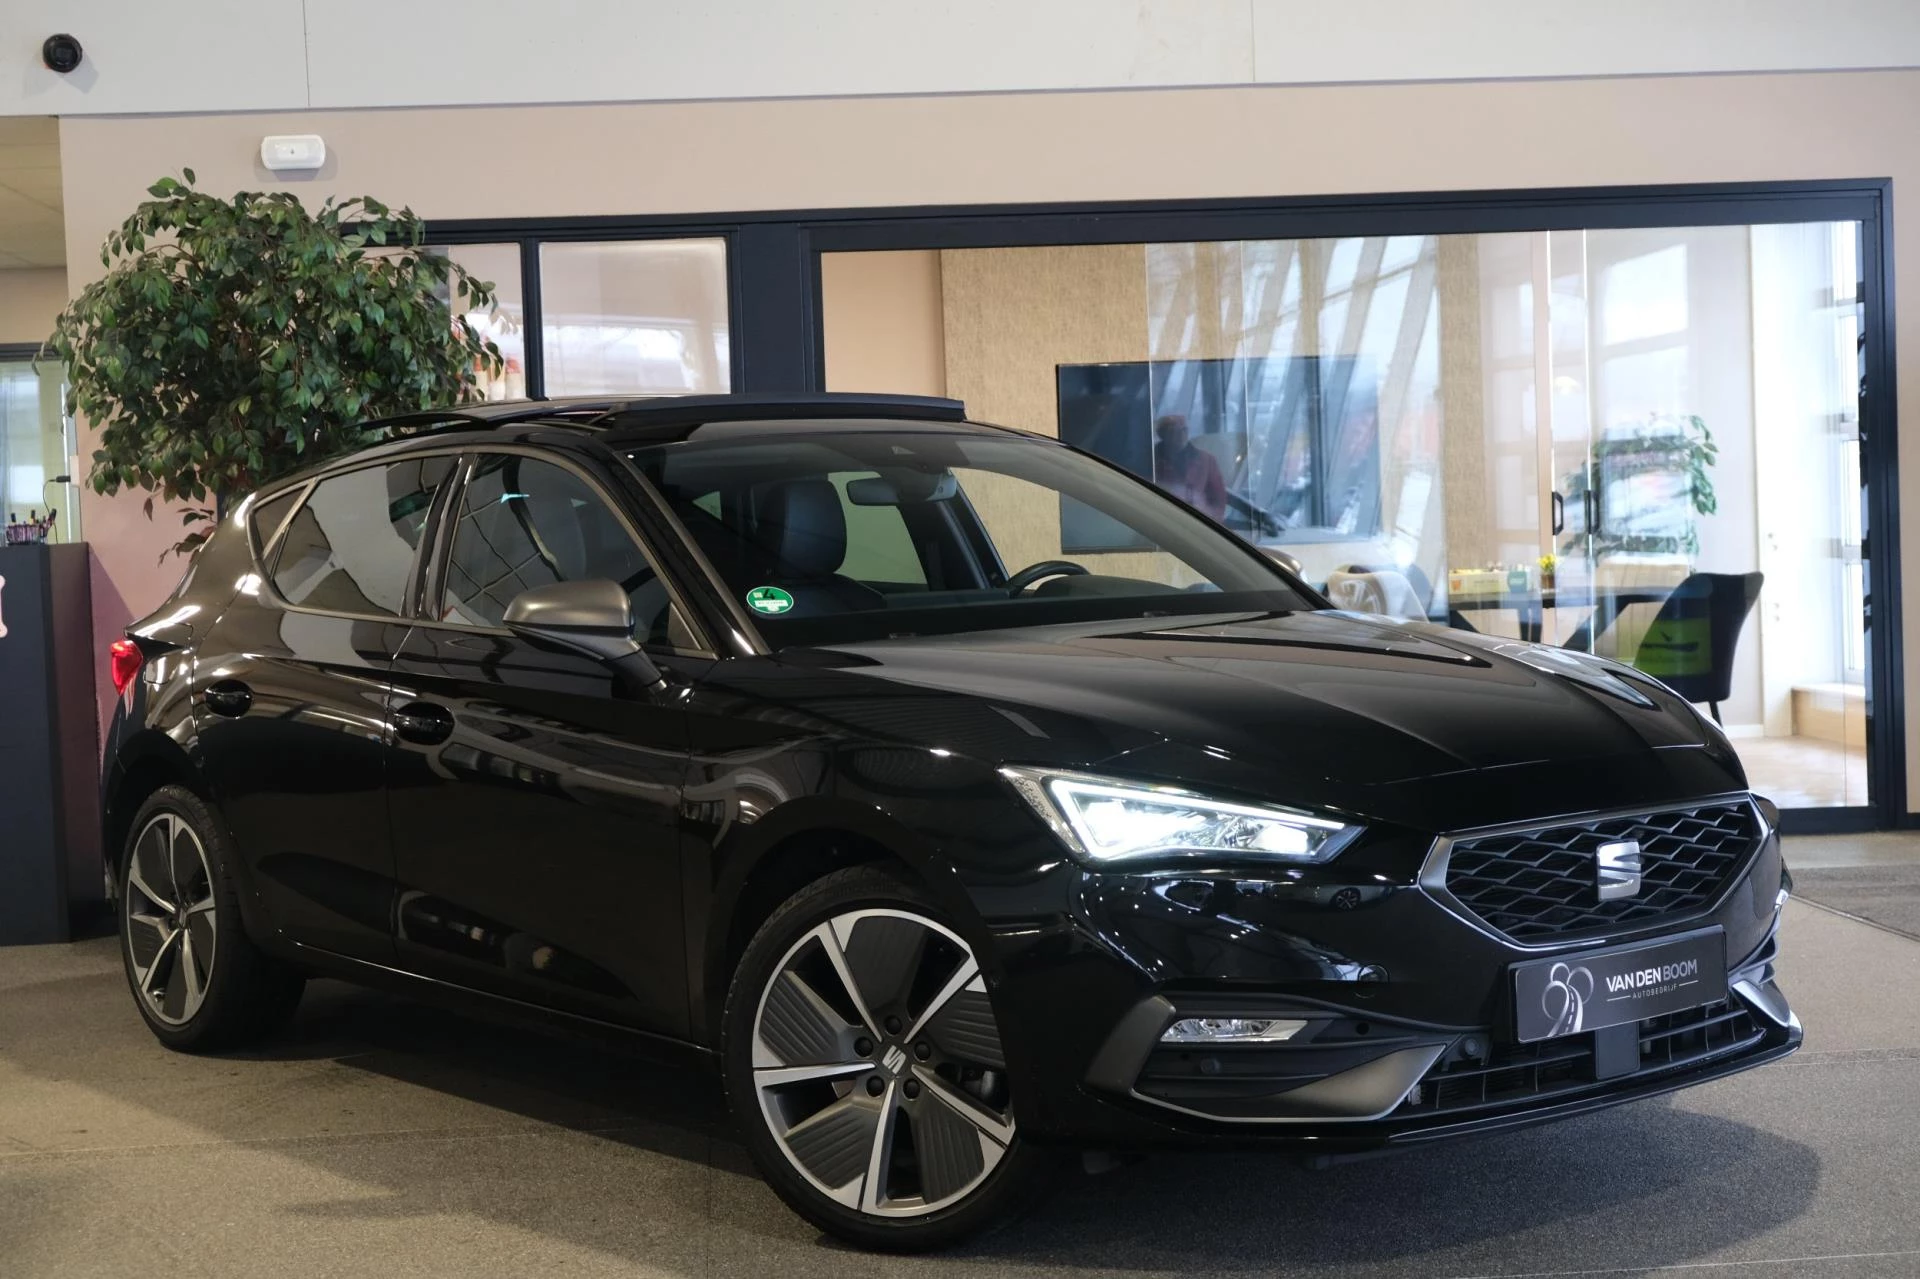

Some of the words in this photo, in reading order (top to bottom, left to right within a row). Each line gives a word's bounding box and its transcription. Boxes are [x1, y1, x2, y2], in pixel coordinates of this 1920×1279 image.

[763, 588, 775, 599] 4
[1606, 973, 1634, 992] VAN
[1636, 967, 1661, 987] DEN
[1663, 959, 1697, 981] BOOM
[1632, 983, 1677, 999] AUTOBEDRIJF
